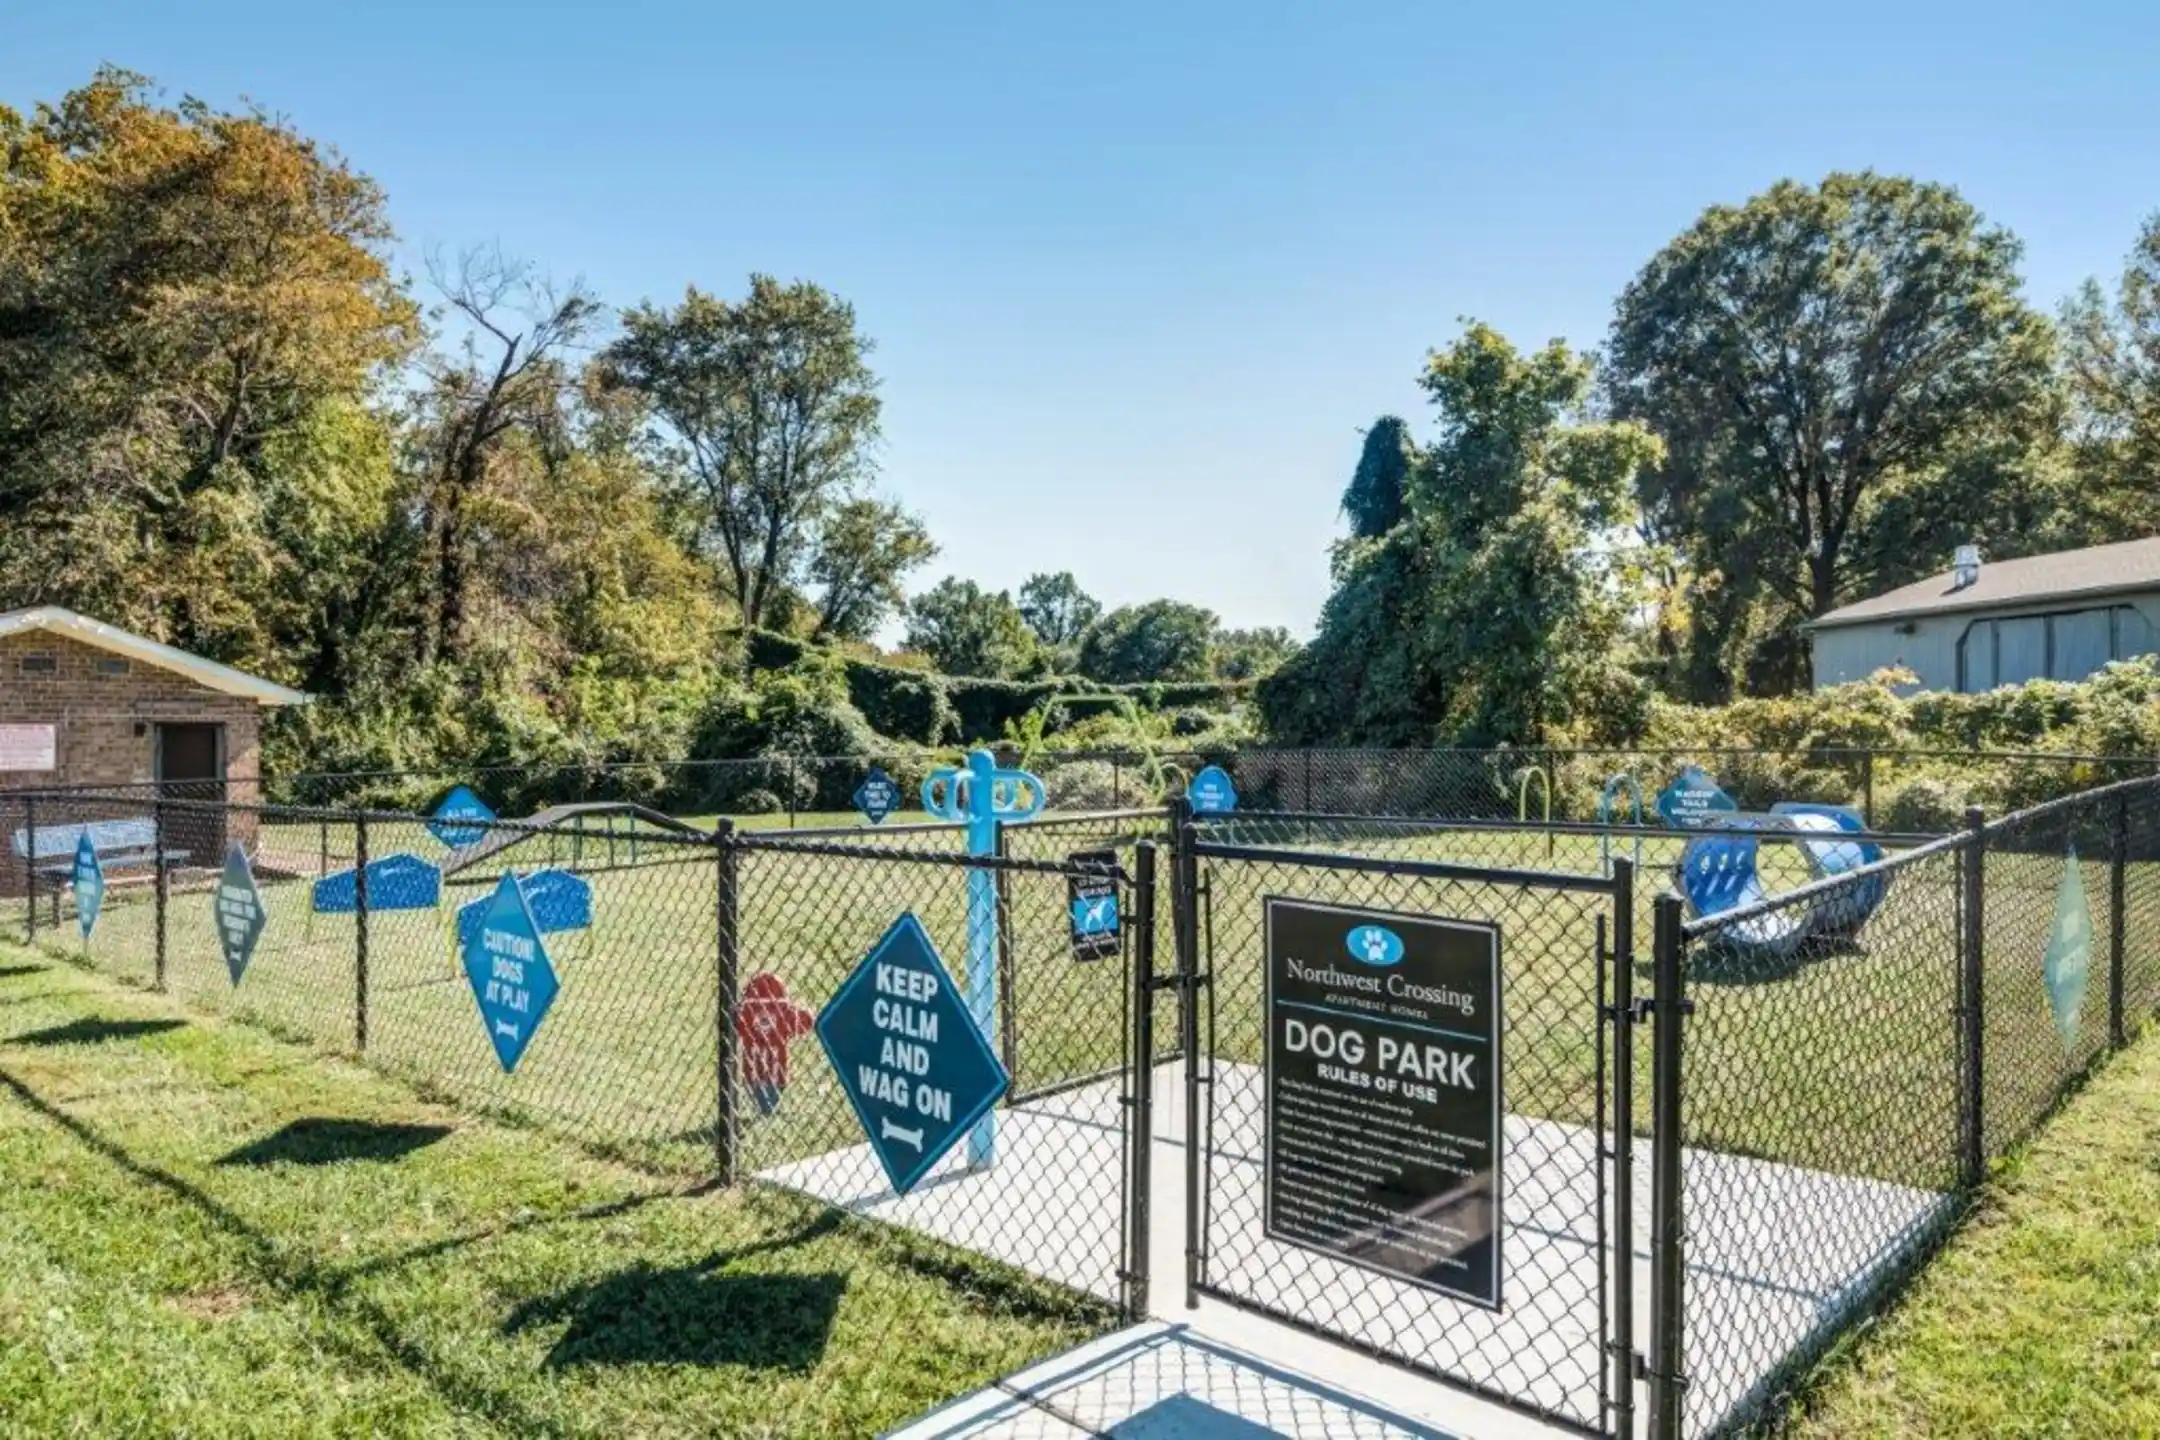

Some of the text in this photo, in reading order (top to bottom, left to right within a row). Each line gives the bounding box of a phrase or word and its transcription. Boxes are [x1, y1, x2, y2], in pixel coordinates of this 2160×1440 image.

[492, 955, 523, 985] DOGS
[876, 961, 938, 1003] KEEP
[1287, 957, 1475, 1017] Northwest Crossing
[486, 979, 530, 1013] AT PLAY
[872, 998, 938, 1043] CALM
[880, 1036, 930, 1076] AND
[1285, 1018, 1476, 1091] DOG PARK
[858, 1064, 952, 1123] WAG ON
[1317, 1063, 1371, 1089] RULES
[1374, 1075, 1398, 1094] OF
[1402, 1080, 1438, 1105] USE
